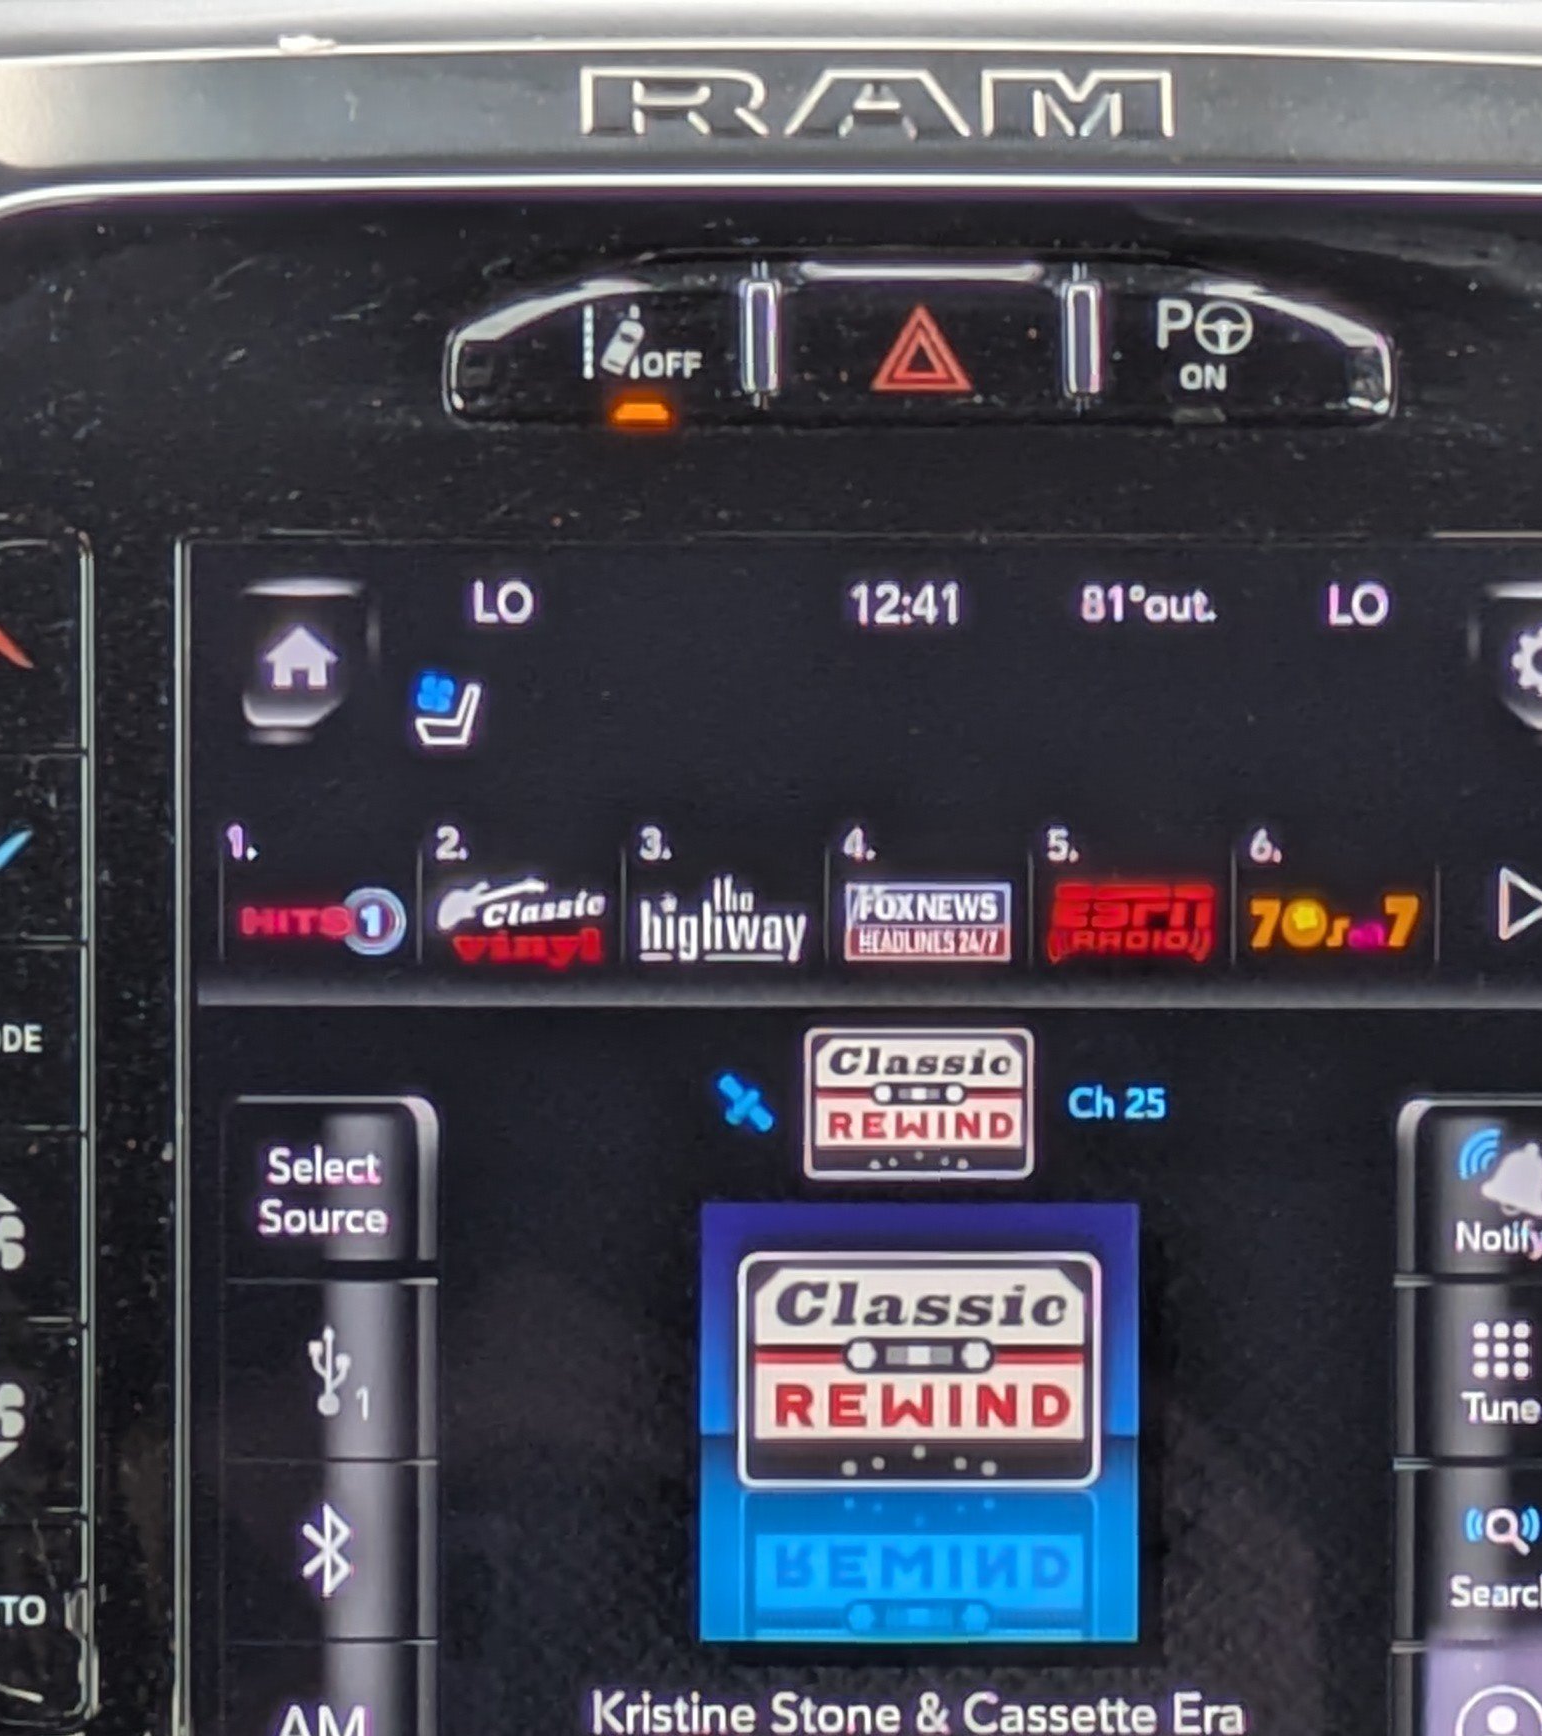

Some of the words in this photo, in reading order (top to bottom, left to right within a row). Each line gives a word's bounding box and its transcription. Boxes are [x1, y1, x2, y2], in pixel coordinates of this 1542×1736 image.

[581, 67, 1173, 138] RAM
[643, 350, 702, 379] OFF
[1179, 362, 1226, 391] ON
[473, 580, 534, 624] LO
[851, 582, 959, 625] 12:41
[1328, 584, 1389, 625] LO
[227, 825, 258, 861] 1.
[436, 826, 468, 861] 2.
[639, 826, 672, 861] 3.
[842, 826, 875, 861] 4.
[1047, 827, 1080, 863] 5.
[1250, 828, 1282, 864] 6.
[240, 906, 353, 937] HITS
[360, 904, 384, 937] 1
[482, 889, 606, 928] Classic
[858, 891, 914, 922] FOX
[916, 892, 999, 922] NEWS
[1053, 883, 1215, 928] ESPN
[1384, 894, 1419, 947] 7
[639, 892, 807, 962] highway
[958, 929, 999, 954] 24/7
[452, 927, 603, 969] vinyl
[829, 1047, 1011, 1076] Classic
[1068, 1086, 1116, 1119] Ch
[1124, 1086, 1167, 1119] 25
[828, 1111, 1014, 1140] REWIND
[267, 1145, 382, 1185] Select
[258, 1199, 389, 1234] Source
[775, 1279, 1067, 1328] Classic
[356, 1386, 370, 1421] 1
[775, 1383, 1072, 1428] REWIND
[1460, 1391, 1542, 1424] Tune
[592, 1691, 756, 1735] Kristine
[770, 1691, 901, 1735] Stone
[915, 1691, 950, 1735] &
[962, 1691, 1158, 1735] Cassette
[1172, 1691, 1247, 1735] Era
